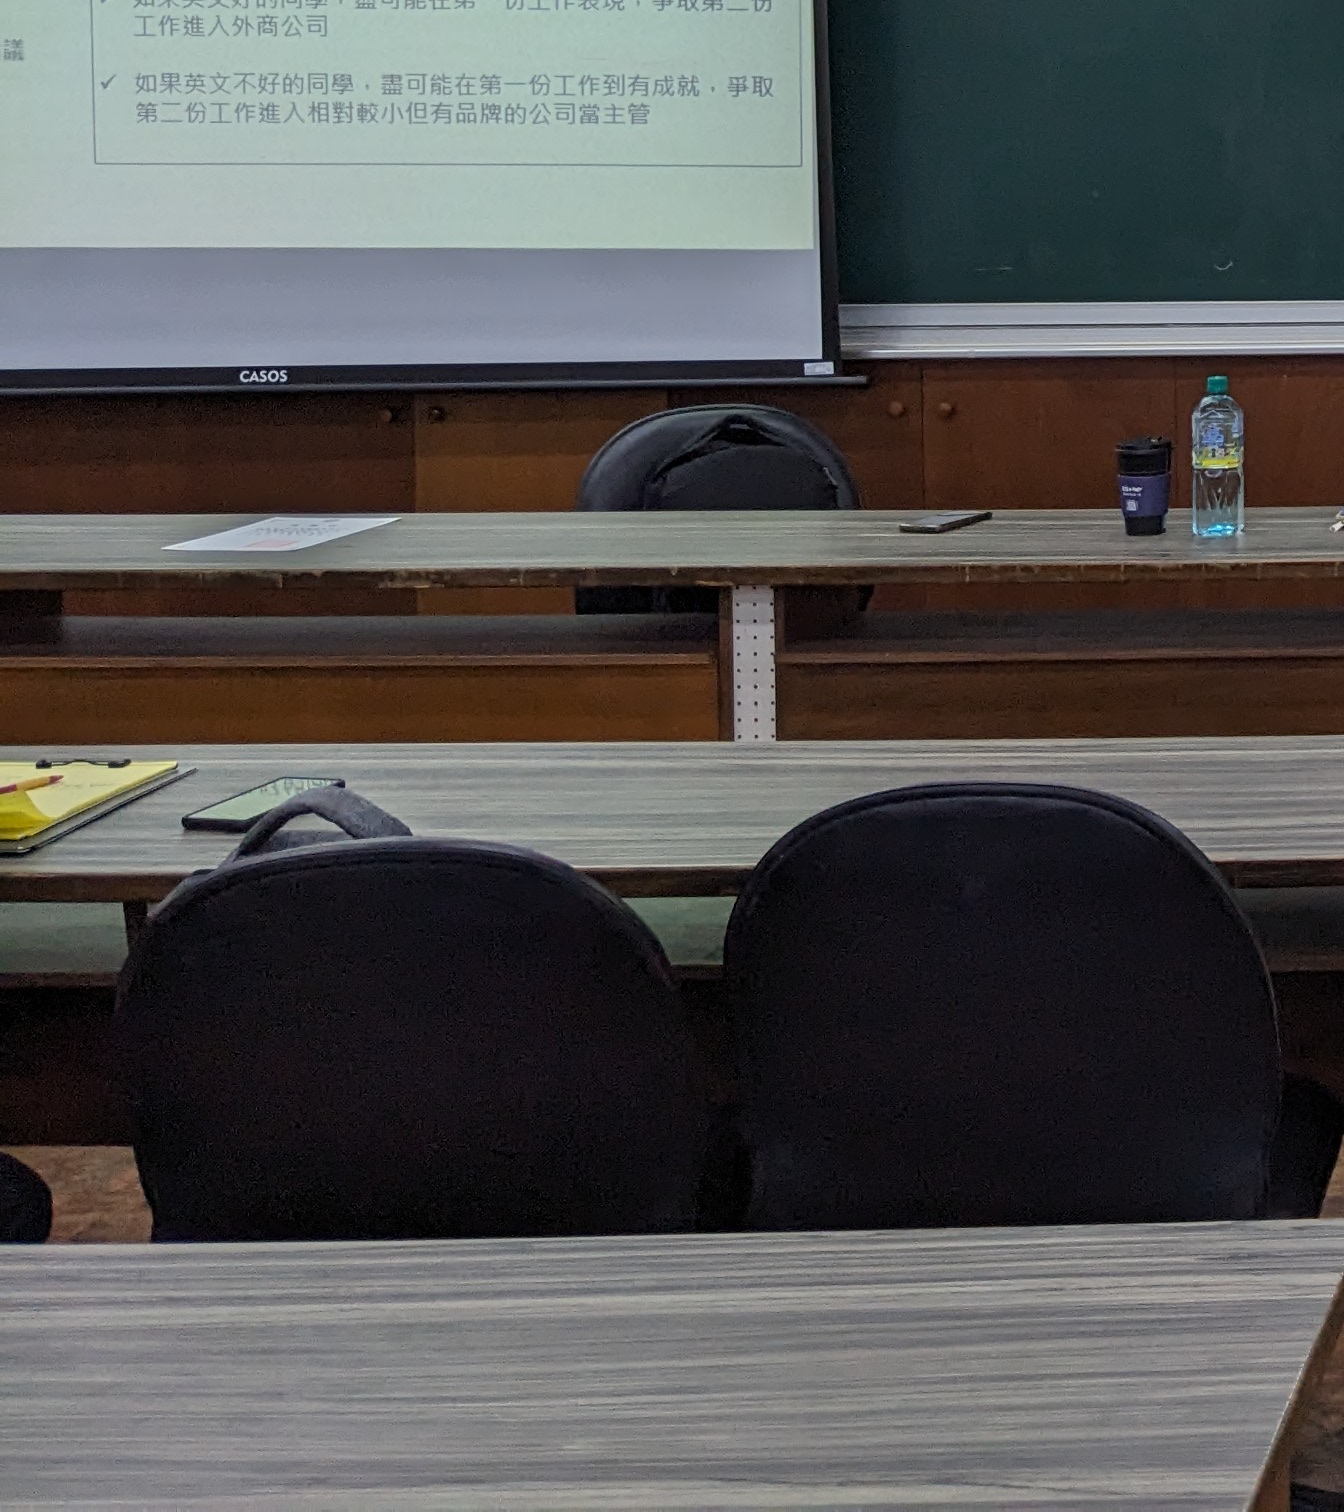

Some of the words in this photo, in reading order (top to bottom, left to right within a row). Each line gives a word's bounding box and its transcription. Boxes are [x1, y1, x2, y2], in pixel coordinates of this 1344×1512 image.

[133, 14, 328, 38] 工作進入外商公司
[239, 369, 288, 384] CASOS
